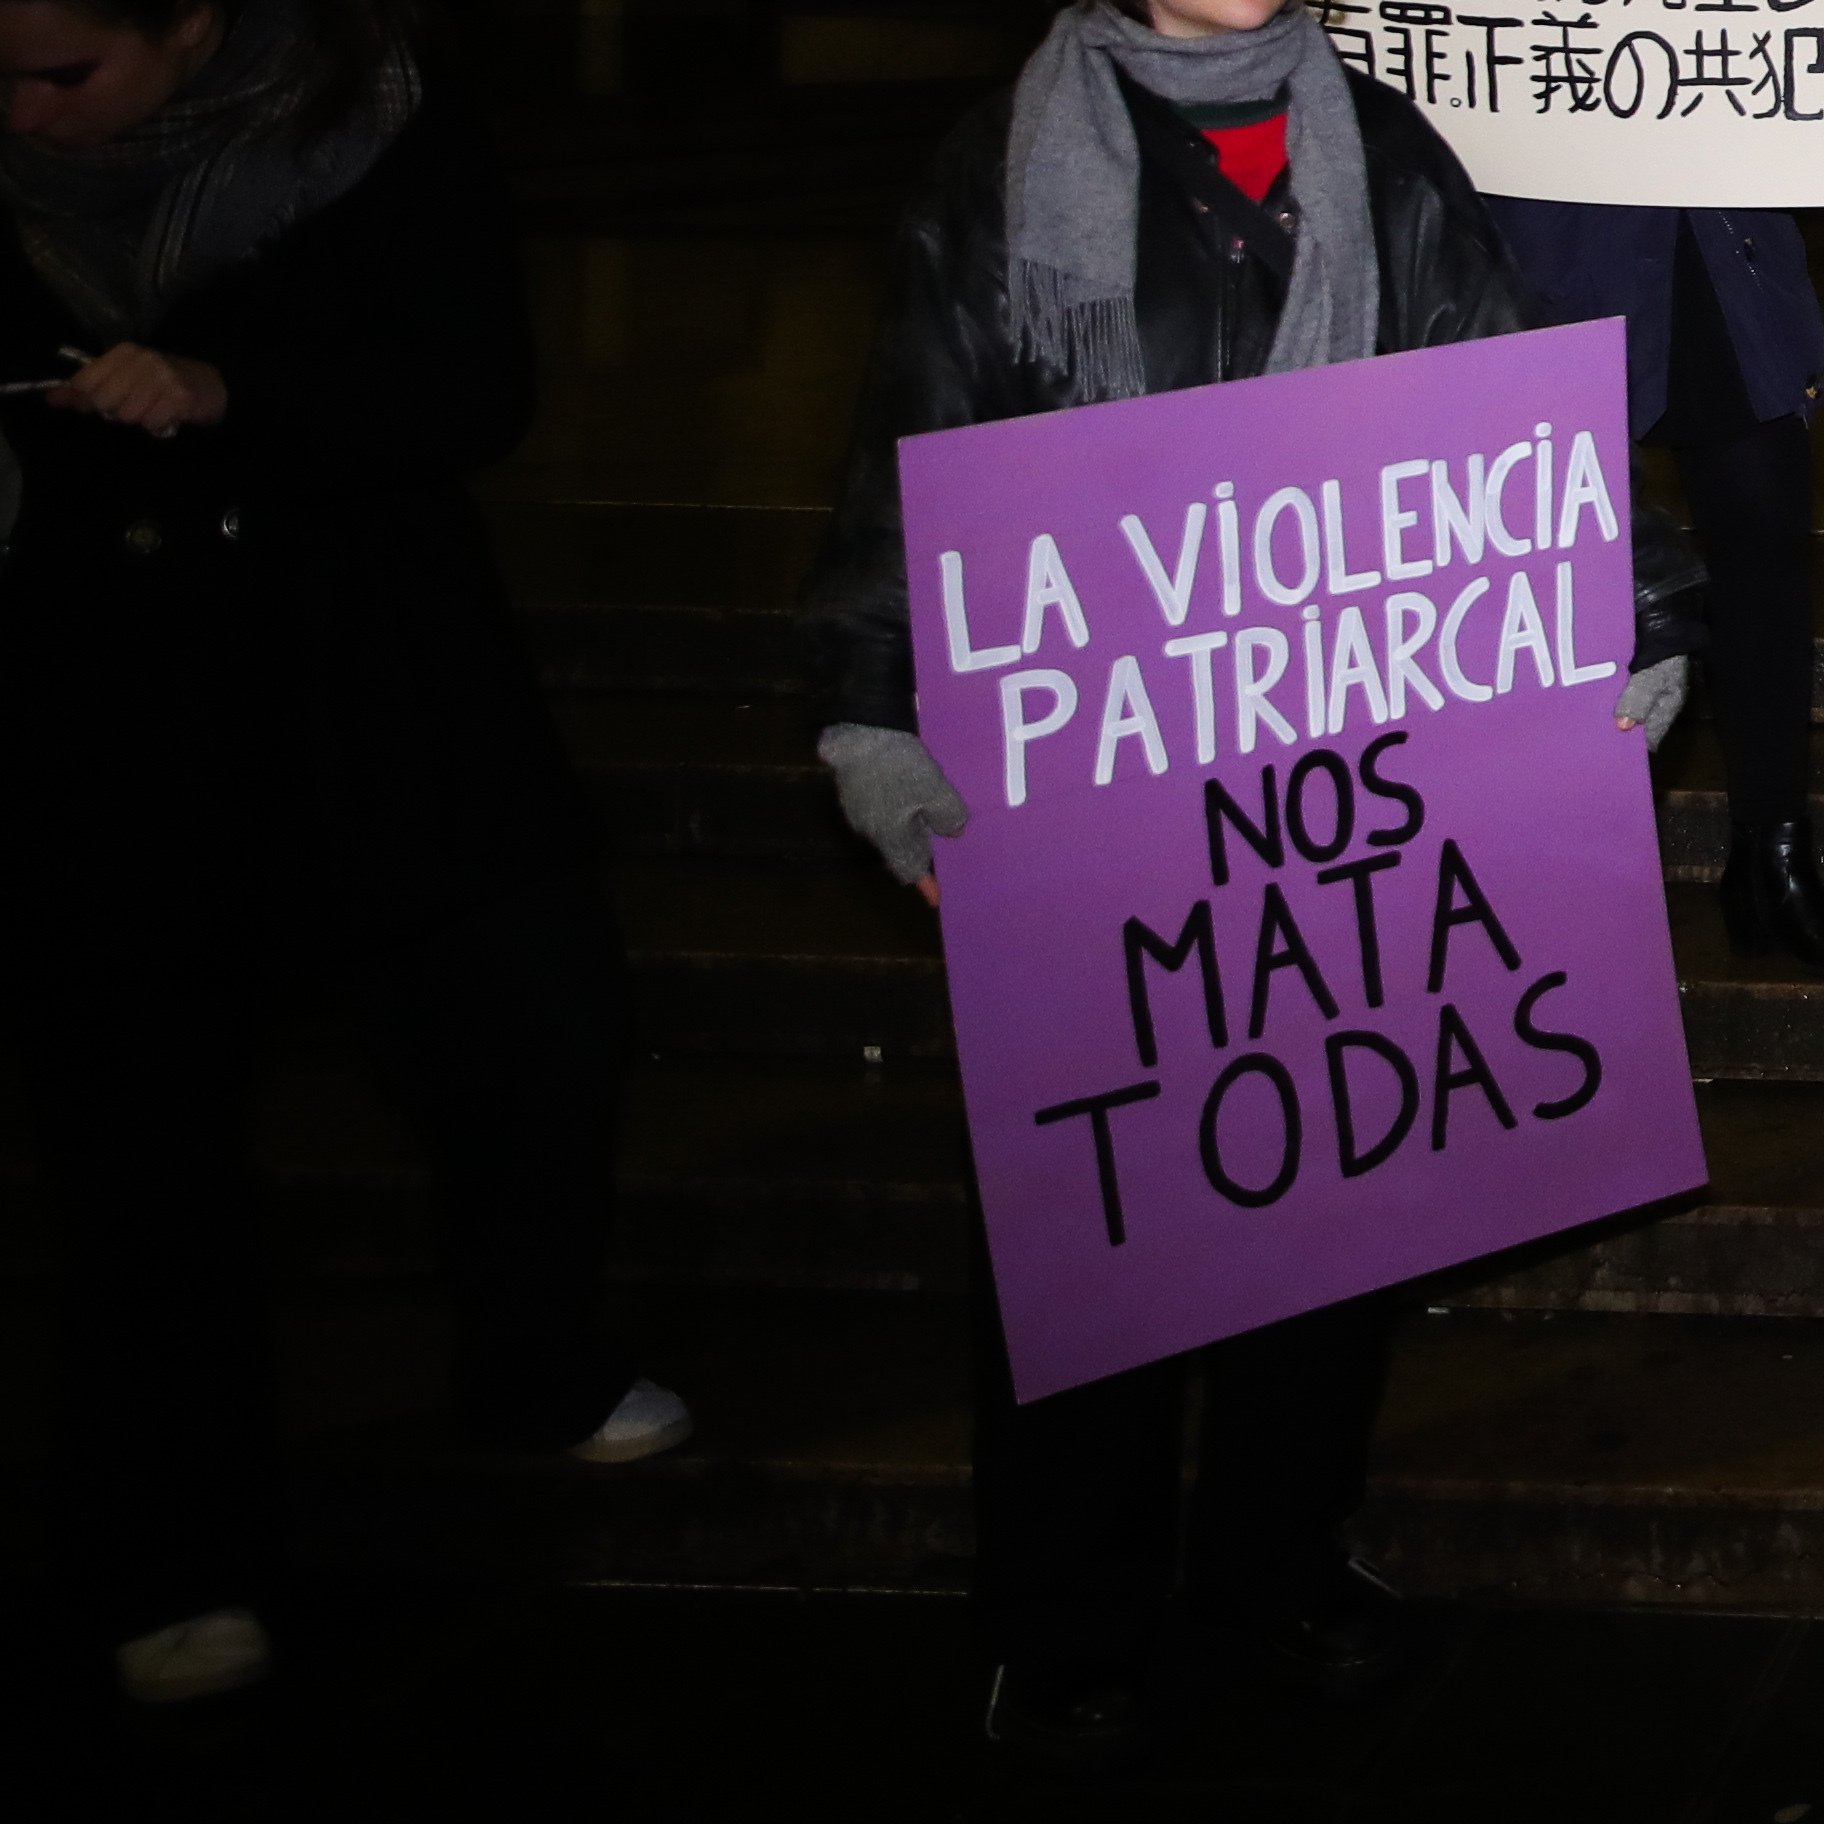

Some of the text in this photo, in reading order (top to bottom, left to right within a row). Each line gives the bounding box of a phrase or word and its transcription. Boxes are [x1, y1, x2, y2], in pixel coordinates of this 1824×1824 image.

[939, 422, 1618, 672] LA VIOLENCIA
[1000, 558, 1616, 806] PATRIARCAL
[1203, 730, 1425, 887] NOS
[1122, 837, 1521, 1068] MATA
[1033, 970, 1604, 1248] TODAS
